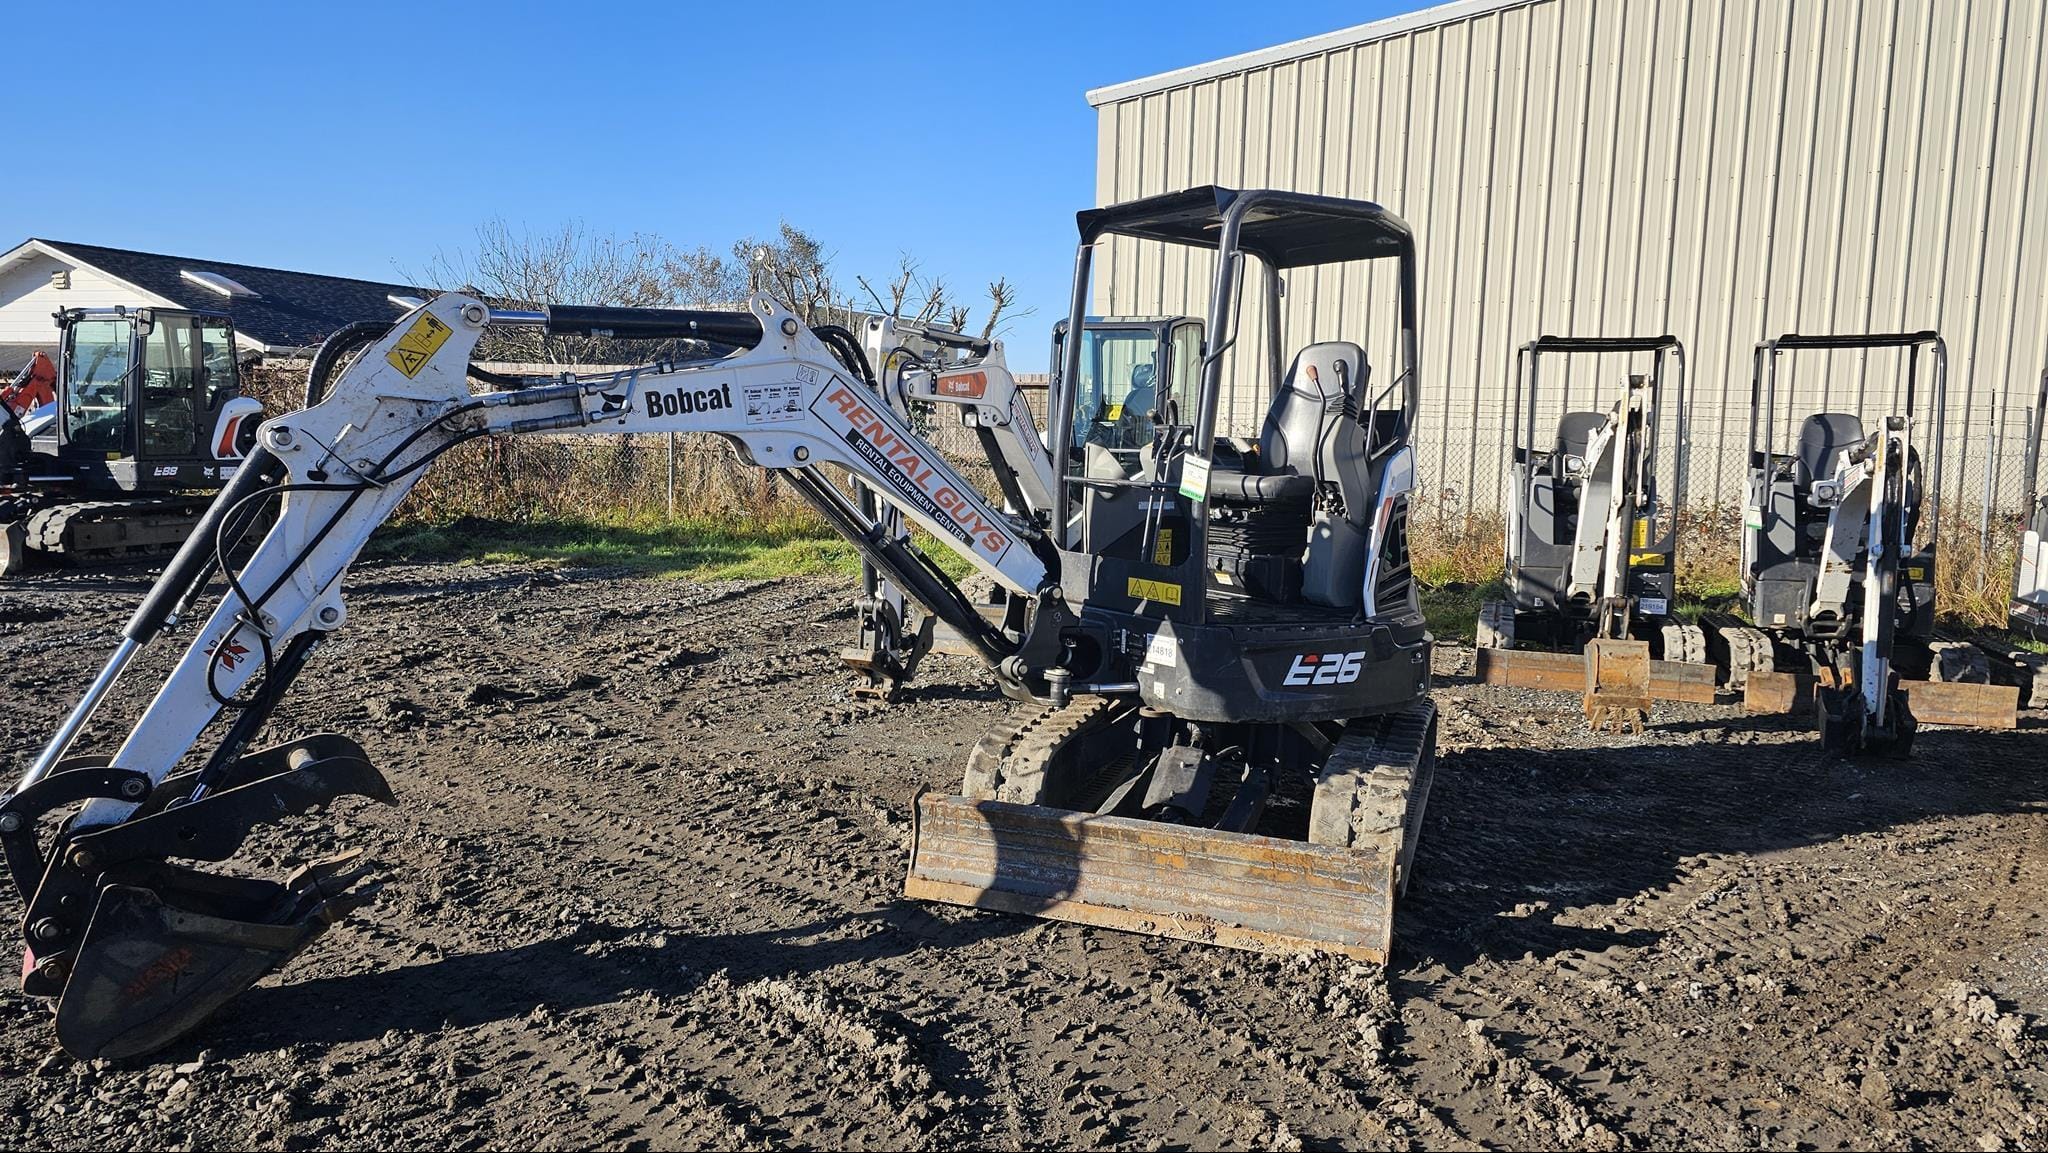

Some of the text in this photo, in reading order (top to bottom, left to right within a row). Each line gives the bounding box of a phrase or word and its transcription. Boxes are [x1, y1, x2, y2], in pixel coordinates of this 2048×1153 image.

[645, 383, 732, 418] Bobcat
[827, 388, 1004, 552] RENTAL GUYS
[856, 438, 966, 542] RENTAL EQUIPMENT CENTER
[1282, 651, 1366, 686] E26
